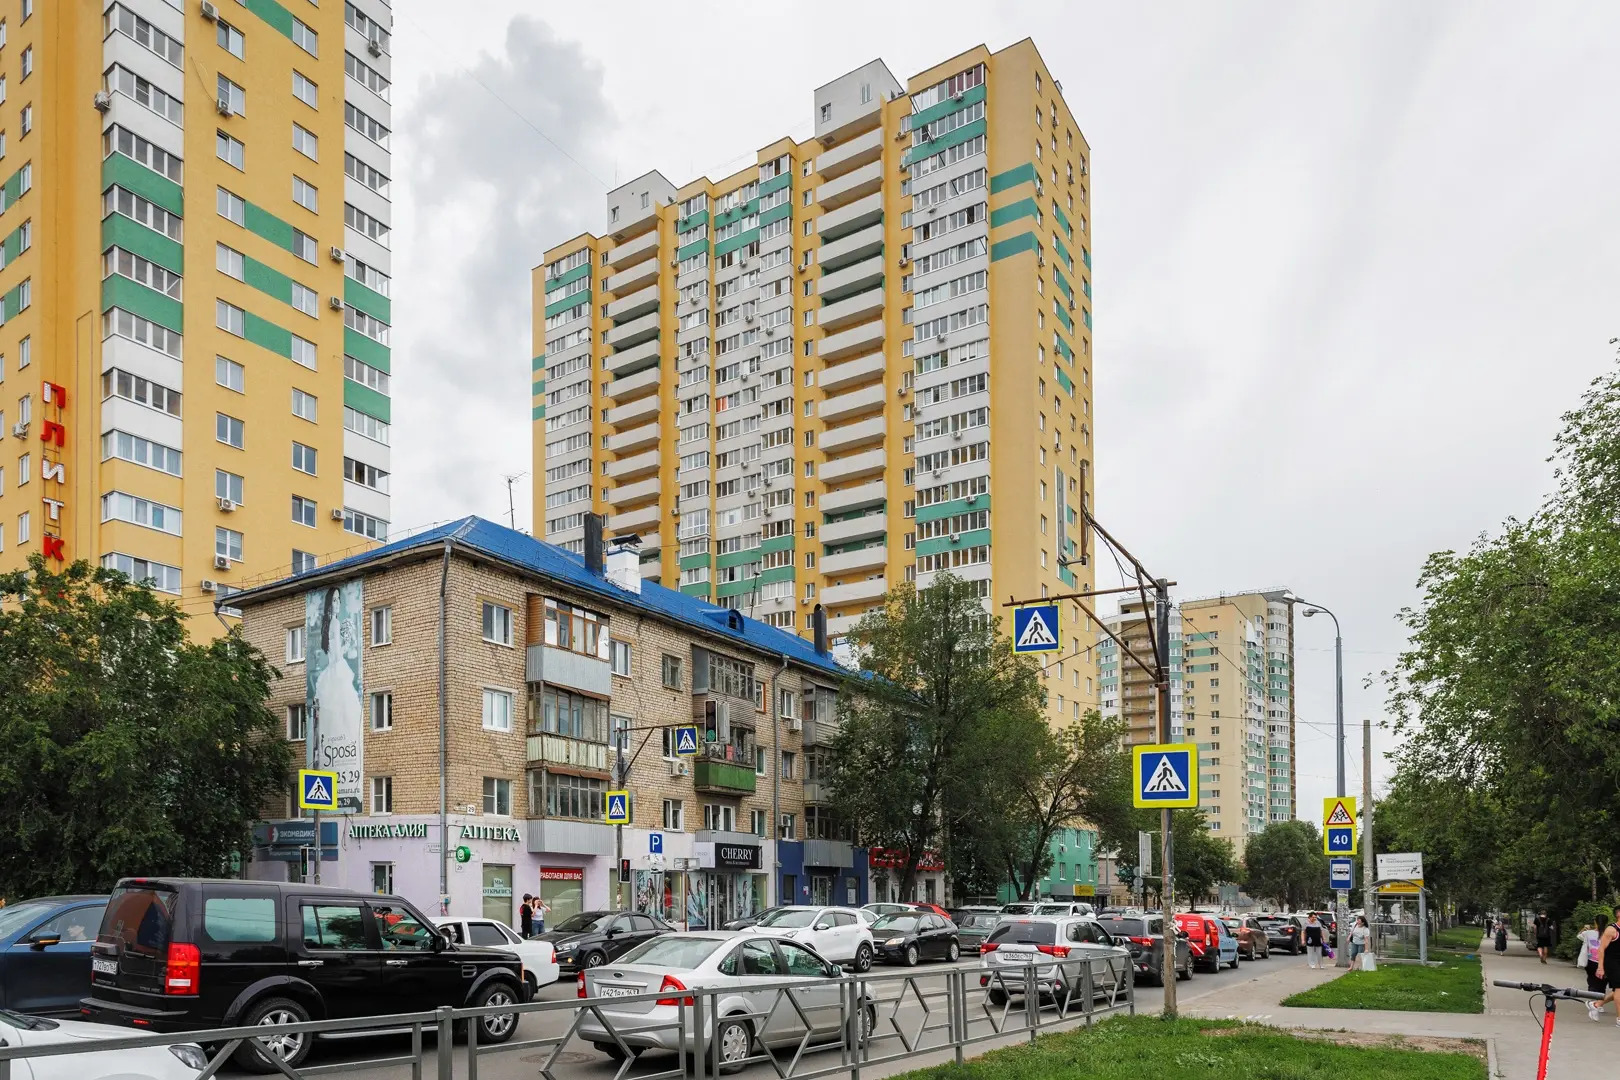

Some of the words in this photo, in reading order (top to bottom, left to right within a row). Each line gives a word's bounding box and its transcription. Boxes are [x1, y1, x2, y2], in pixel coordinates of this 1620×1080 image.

[40, 381, 66, 598] ПЛИТК
[348, 770, 360, 783] 29
[348, 823, 393, 839] АПТЕКА
[394, 823, 428, 838] АЛИЯ
[461, 825, 521, 841] АПТЕКА
[1332, 835, 1349, 845] 40
[721, 847, 753, 860] CHERRY
[540, 871, 564, 880] РАБОТАЕМ
[573, 872, 583, 880] ВАС
